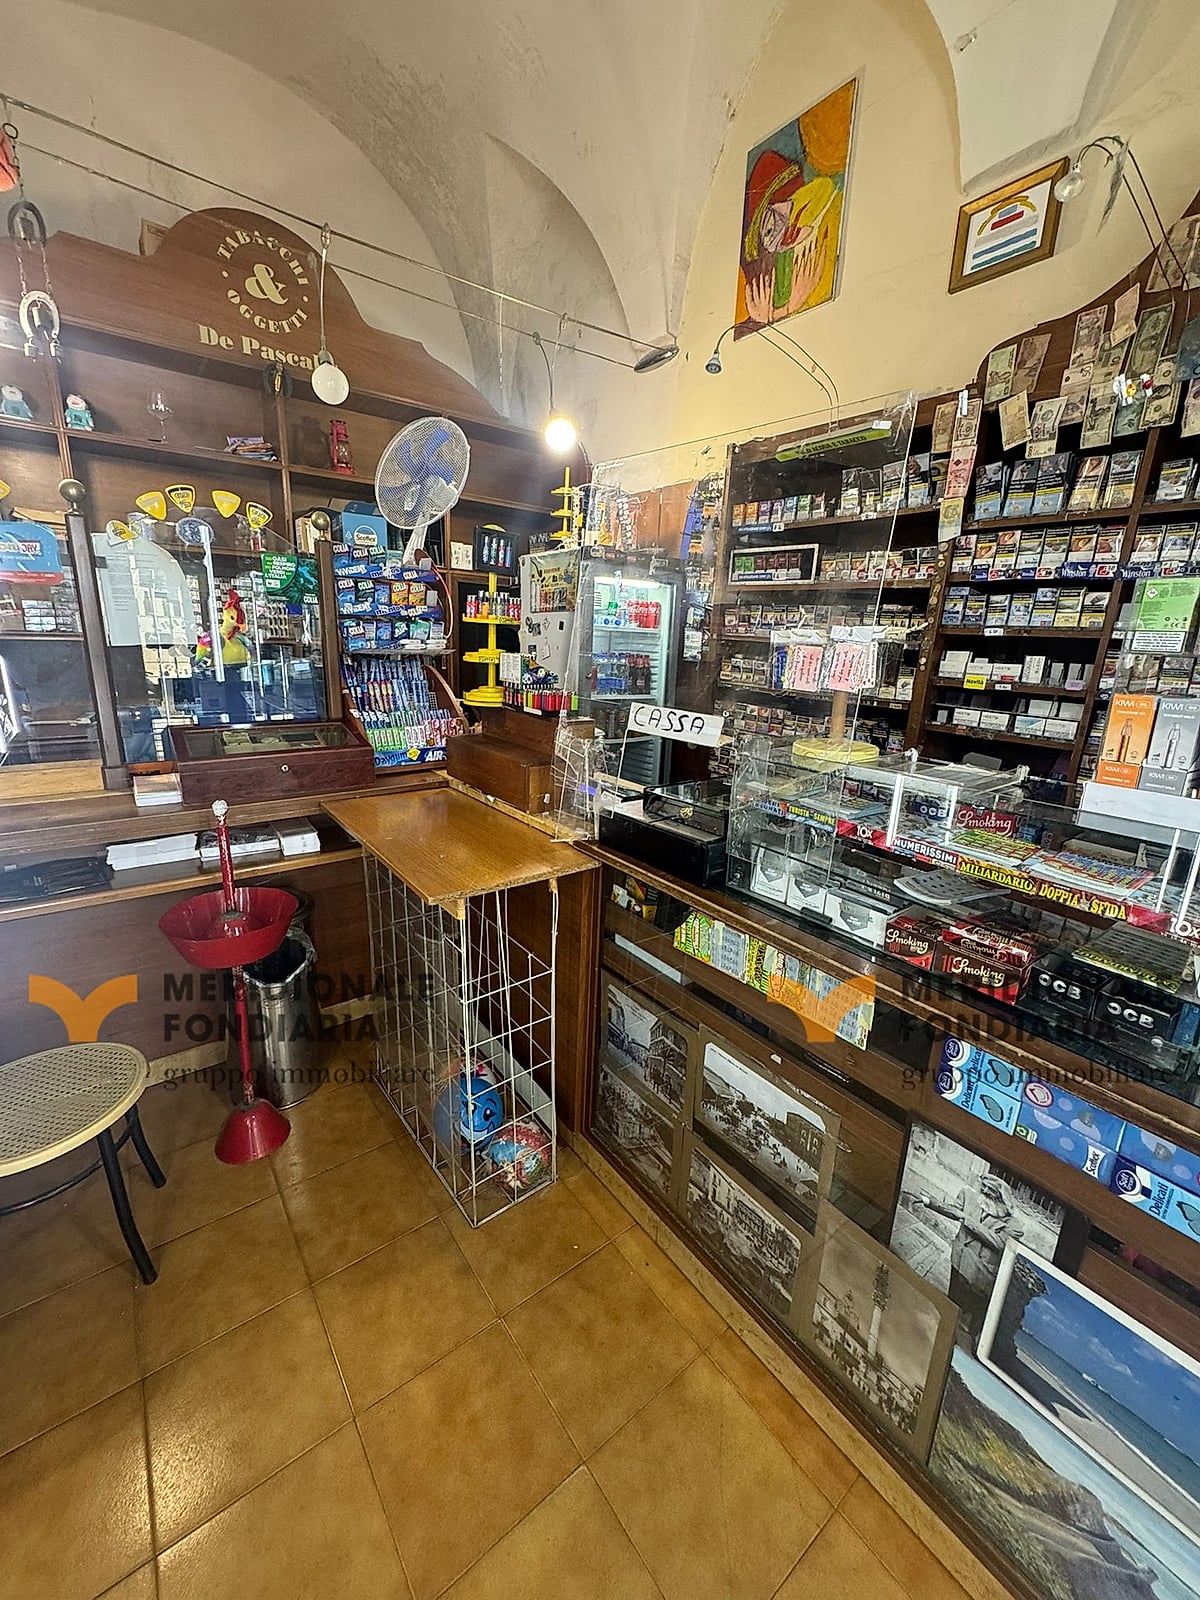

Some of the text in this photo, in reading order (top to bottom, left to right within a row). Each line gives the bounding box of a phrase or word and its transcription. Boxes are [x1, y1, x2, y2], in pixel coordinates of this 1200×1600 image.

[217, 230, 309, 286] TABACCHI
[245, 263, 288, 305] &
[227, 289, 309, 334] OGGETTI
[198, 324, 338, 370] De Pascal
[1061, 568, 1087, 578] Winston
[1121, 568, 1151, 578] Winston
[634, 706, 705, 735] CASSA
[919, 805, 947, 818] OCB
[956, 810, 1013, 837] Smoking
[894, 838, 957, 865] NUMERISSIMI
[959, 862, 1127, 920] MILIARDARIO DOPPIA SFIDA
[885, 929, 929, 954] Smoking
[951, 957, 1006, 987] Smoking
[1039, 973, 1082, 1000] OCB
[1106, 1002, 1154, 1029] OCB
[1149, 1182, 1169, 1216] Delicati
